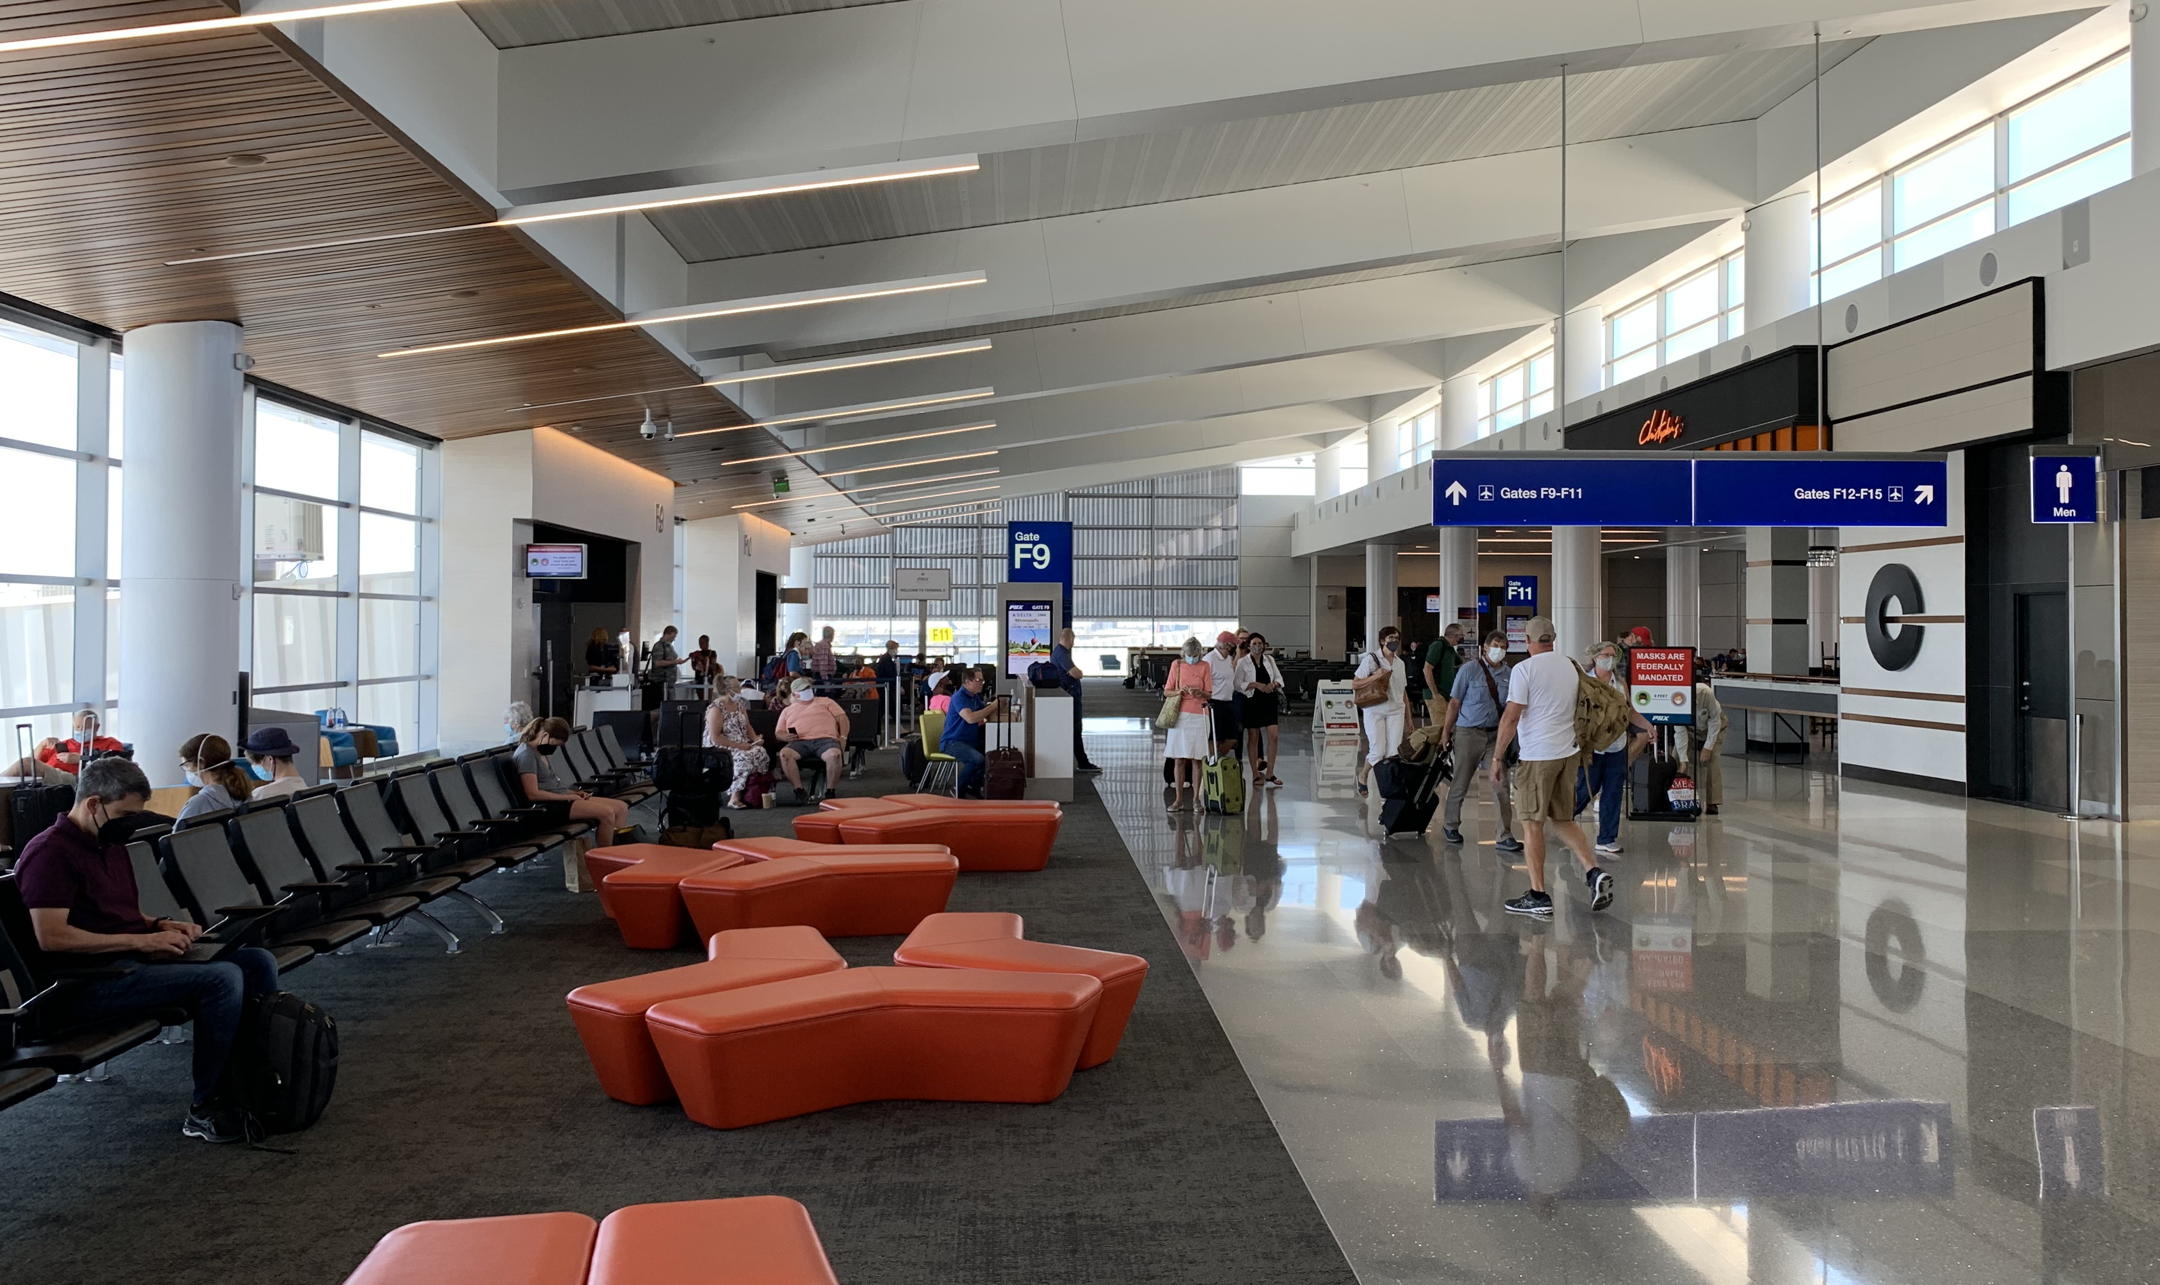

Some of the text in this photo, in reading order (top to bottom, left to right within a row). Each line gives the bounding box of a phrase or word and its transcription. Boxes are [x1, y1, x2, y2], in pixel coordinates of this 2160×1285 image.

[1500, 487, 1583, 499] Gates F9-F11
[1794, 487, 1883, 500] Gates F12-F15
[2053, 506, 2076, 517] Men
[1014, 532, 1040, 542] Gate
[1014, 543, 1051, 570] F9
[1507, 586, 1533, 601] F11
[932, 629, 949, 641] F11
[1636, 652, 1685, 661] MASKS ARE
[1636, 662, 1685, 671] FEDERALLY
[1637, 673, 1684, 682] MANDATED
